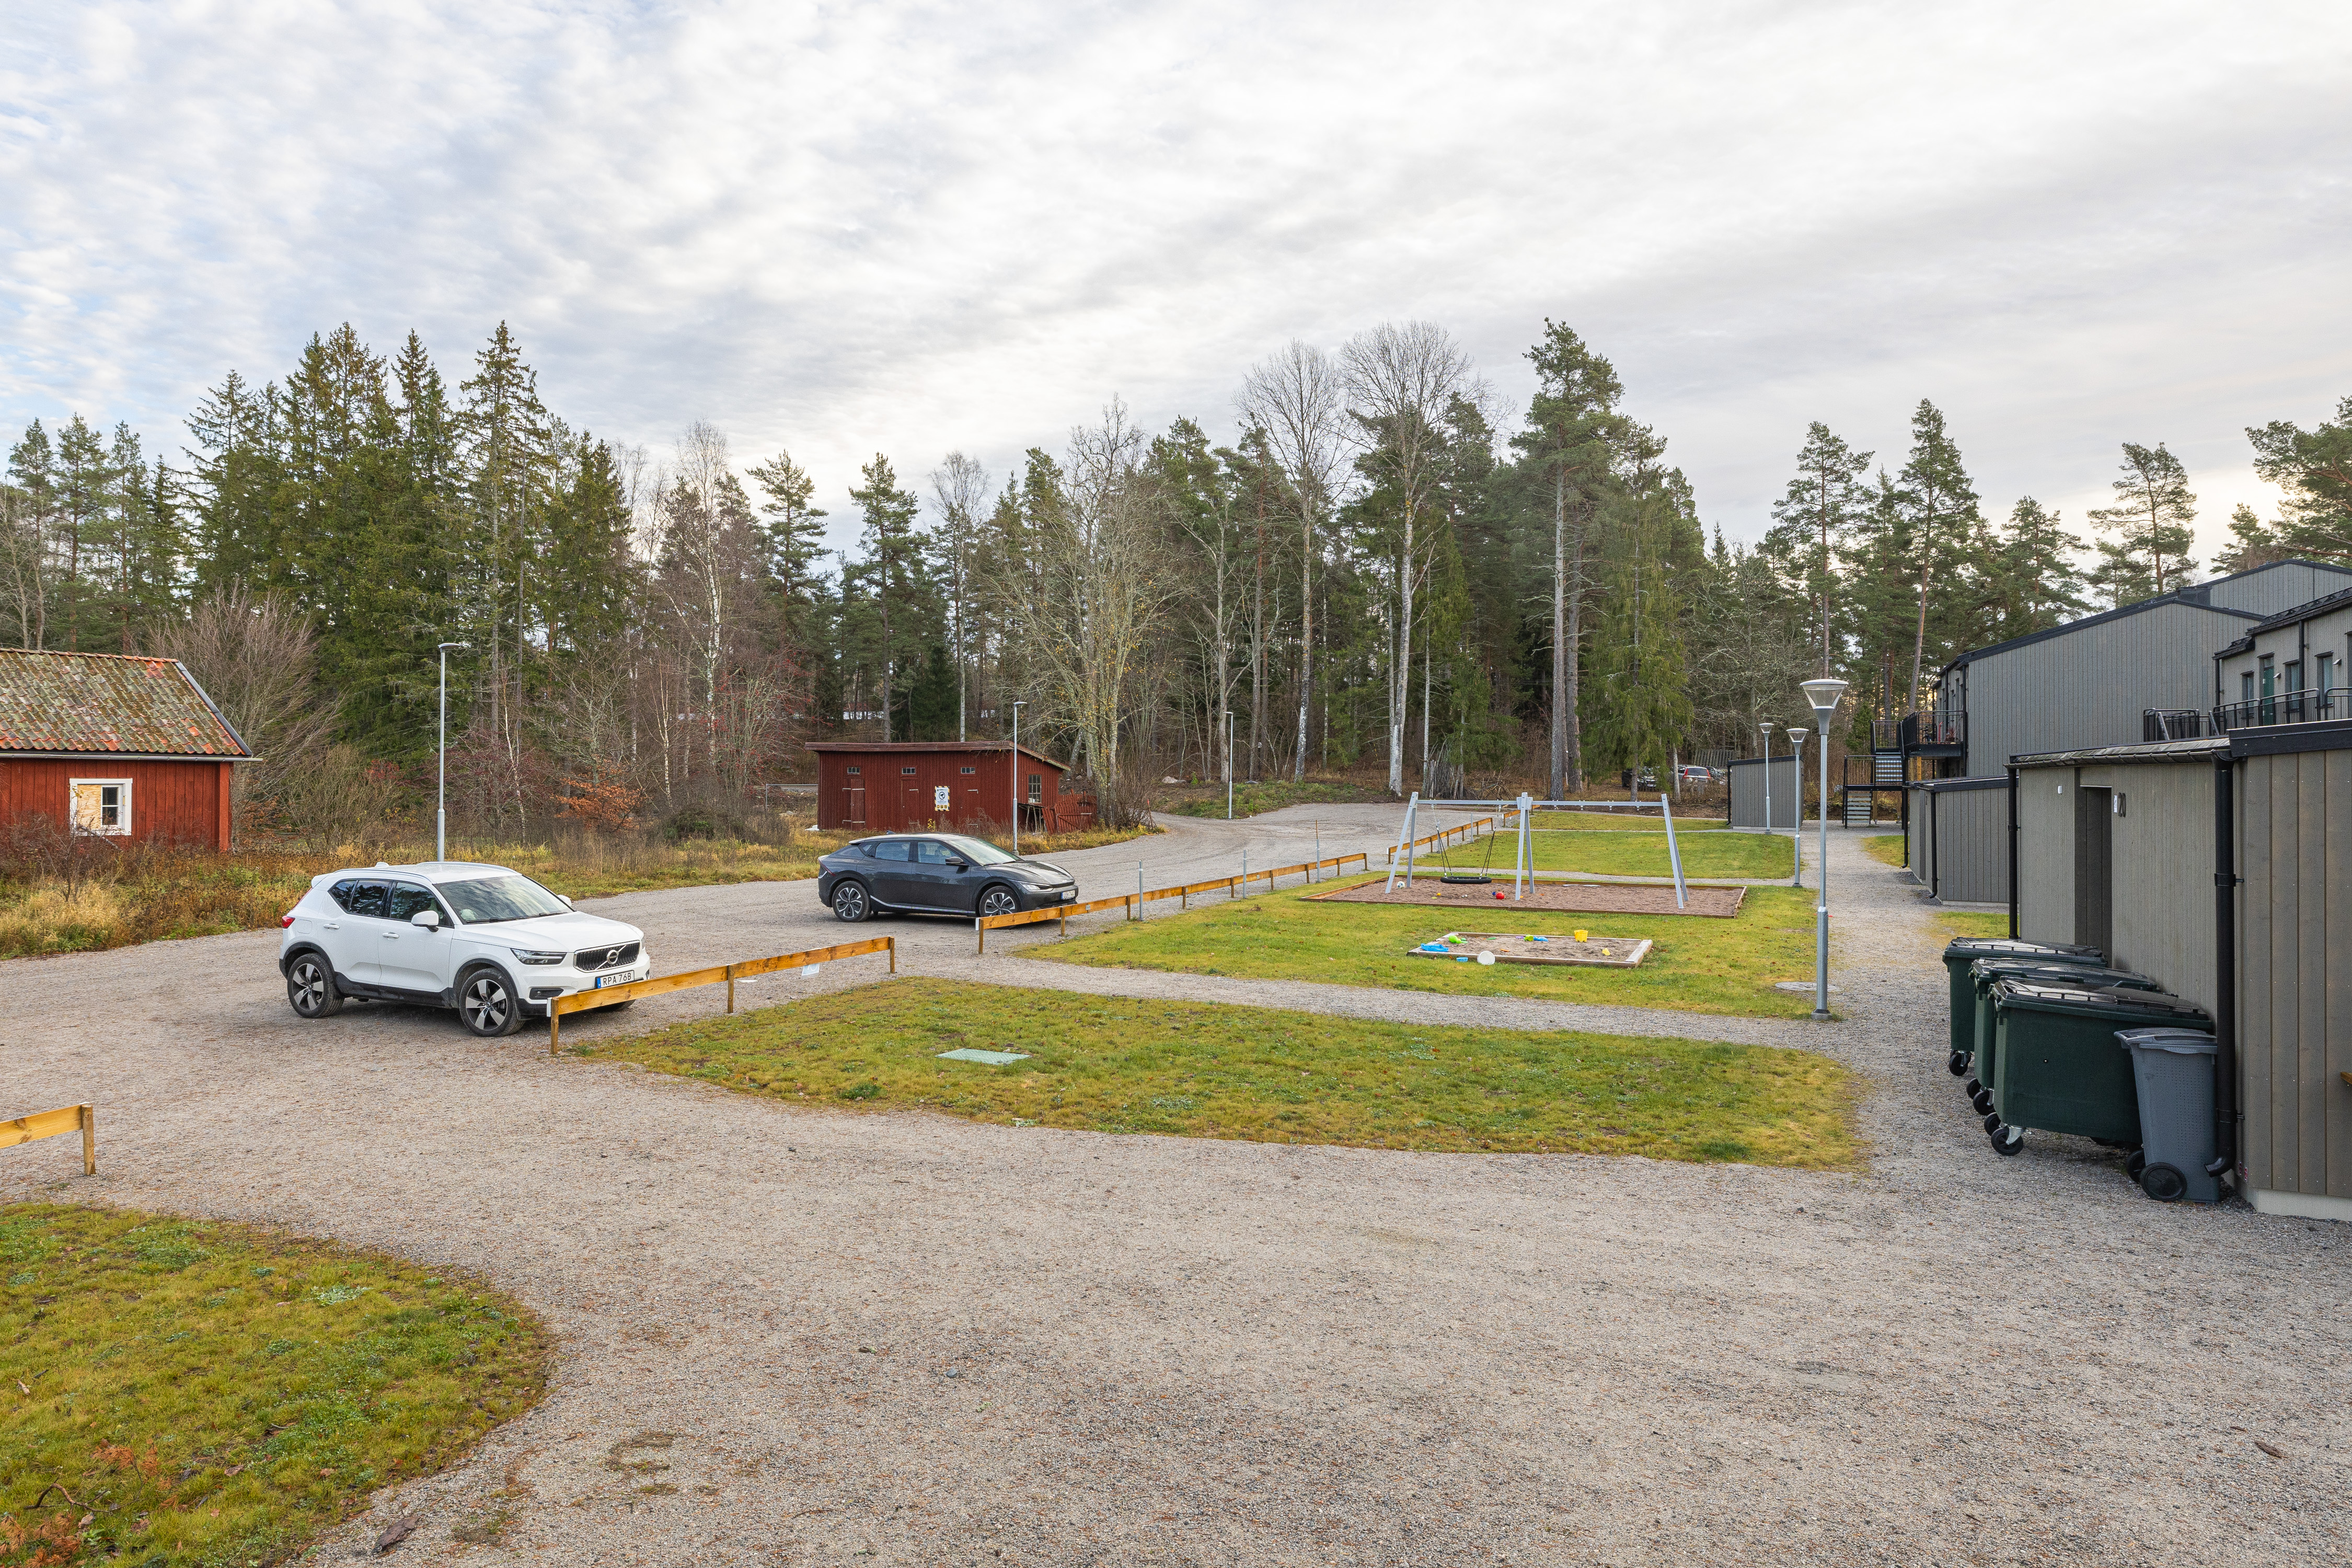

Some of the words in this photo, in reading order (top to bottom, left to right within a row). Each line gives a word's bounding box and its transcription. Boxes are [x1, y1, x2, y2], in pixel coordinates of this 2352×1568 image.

[2118, 792, 2126, 817] 20
[603, 976, 617, 986] RPA
[619, 972, 631, 982] 76B
